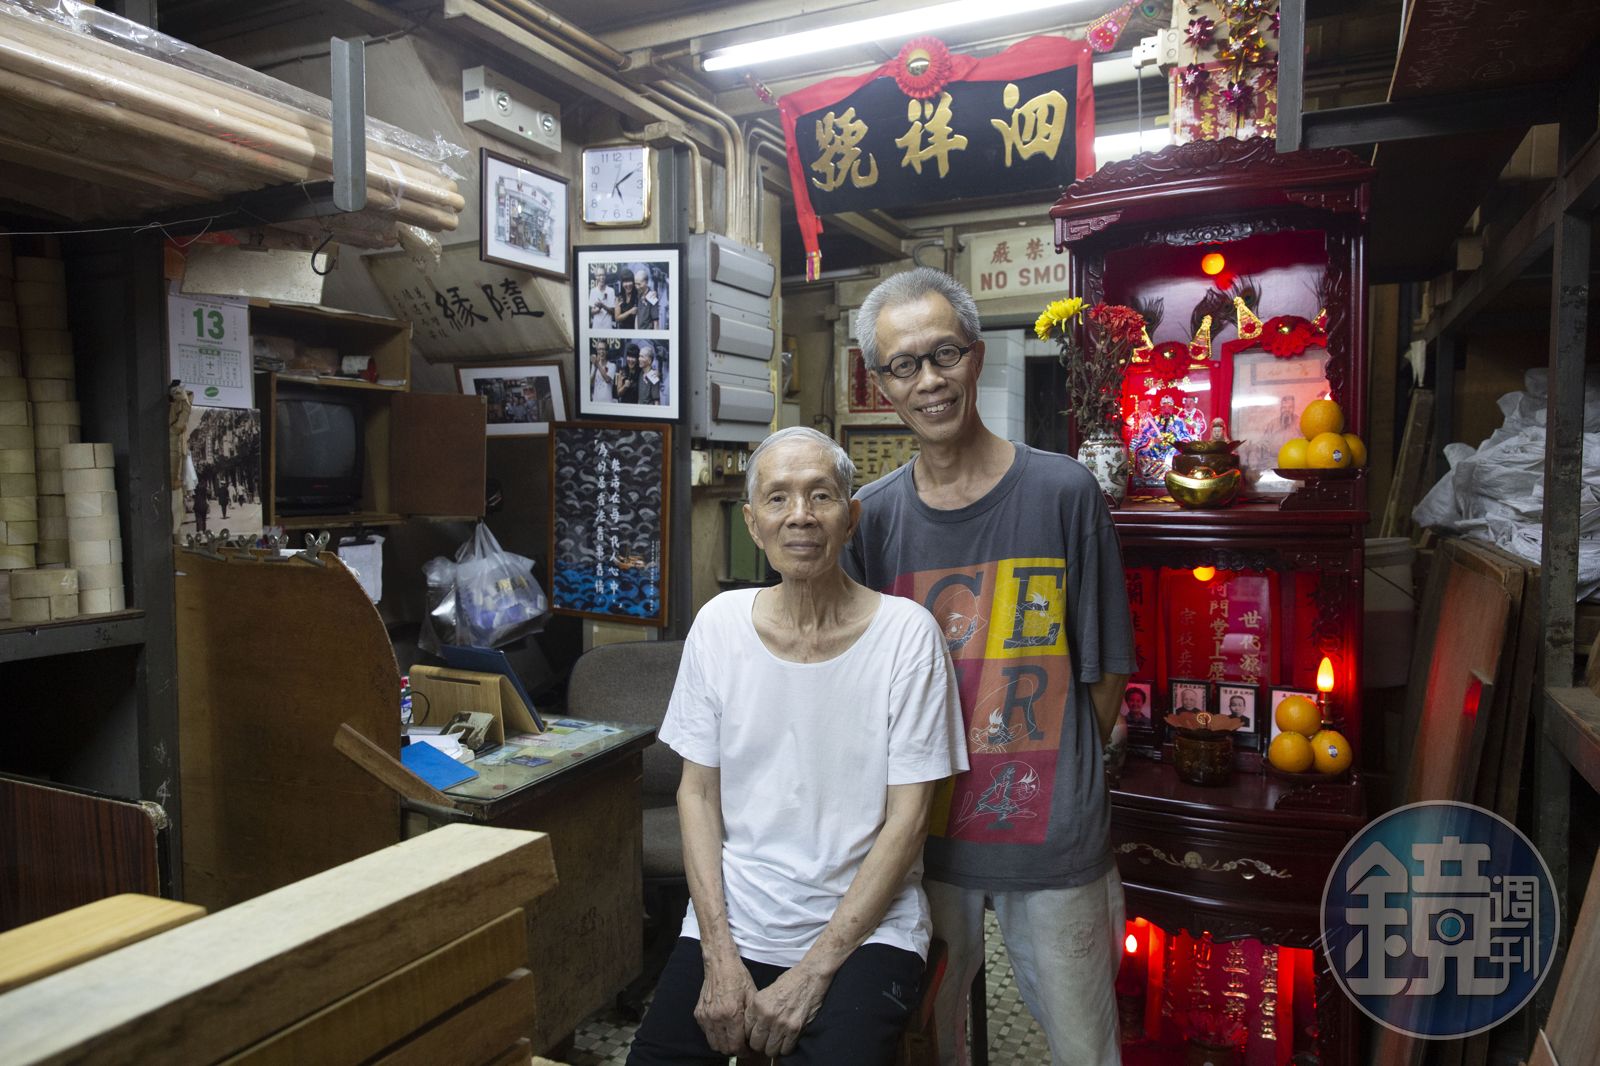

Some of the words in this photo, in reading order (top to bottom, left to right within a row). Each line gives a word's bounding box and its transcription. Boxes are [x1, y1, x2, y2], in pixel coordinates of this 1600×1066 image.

[602, 153, 609, 163] 11
[613, 152, 622, 162] 12
[591, 165, 600, 175] 10
[591, 182, 598, 191] 9
[636, 180, 643, 189] 3
[591, 198, 598, 208] 8
[600, 210, 608, 218] 7
[614, 209, 620, 218] 6
[626, 209, 633, 218] 5
[980, 271, 1008, 291] NO
[1019, 263, 1066, 286] SMO
[193, 307, 225, 340] 13
